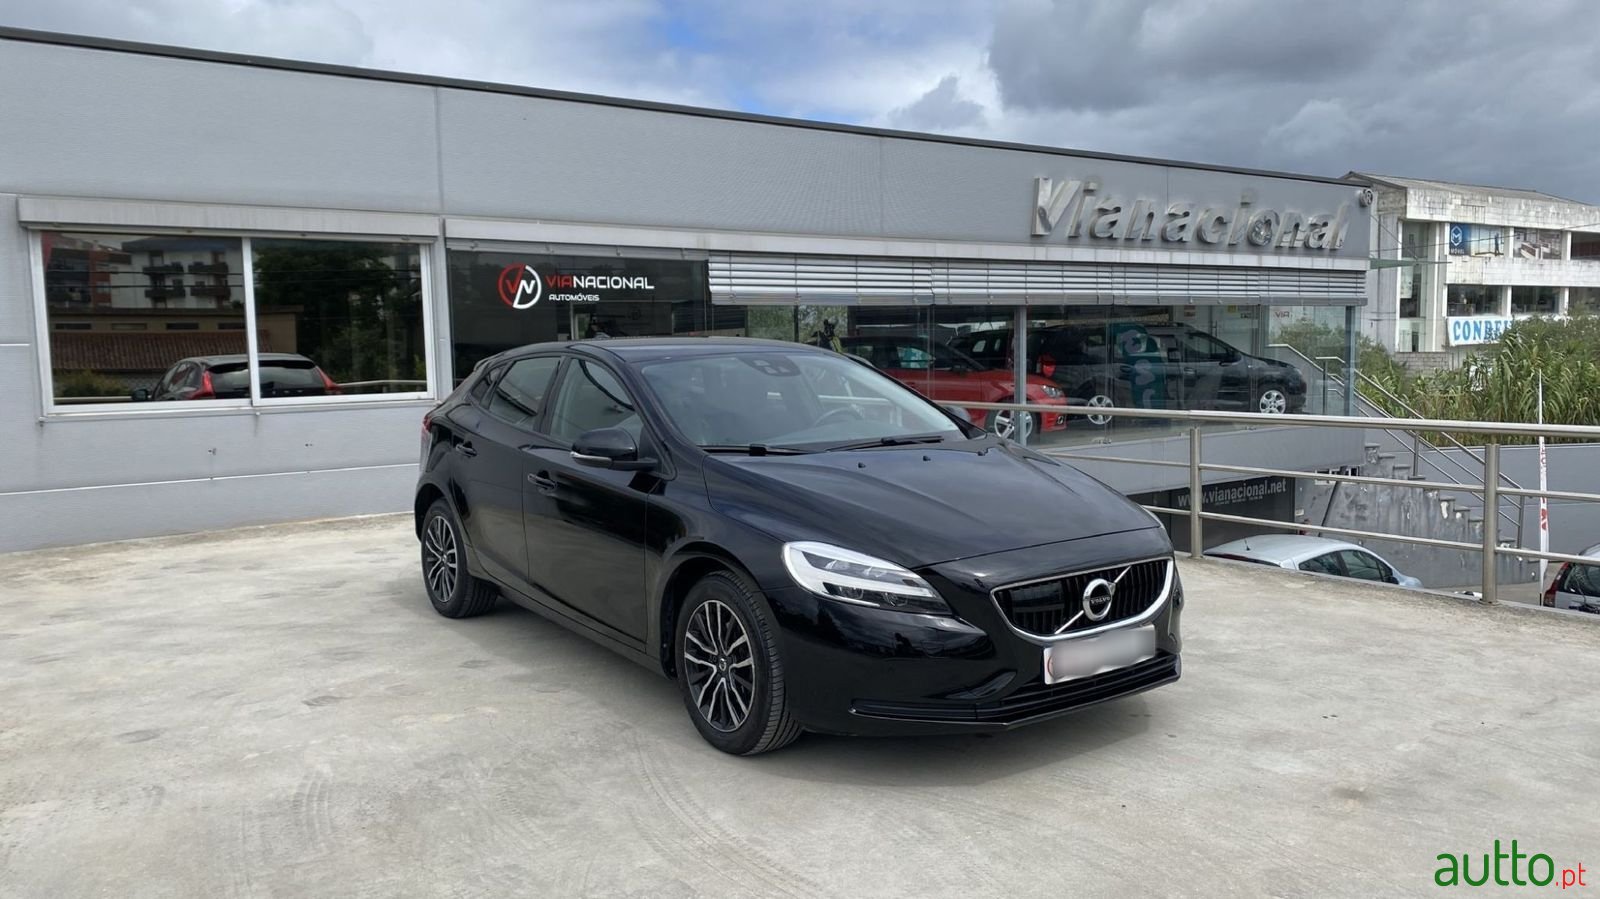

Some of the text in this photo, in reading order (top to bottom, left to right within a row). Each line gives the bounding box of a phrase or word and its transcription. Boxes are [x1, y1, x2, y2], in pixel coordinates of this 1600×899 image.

[1031, 177, 1350, 250] Vianacional
[545, 275, 655, 289] VIANACIONAL
[548, 293, 600, 302] AUTOMÓVEIS
